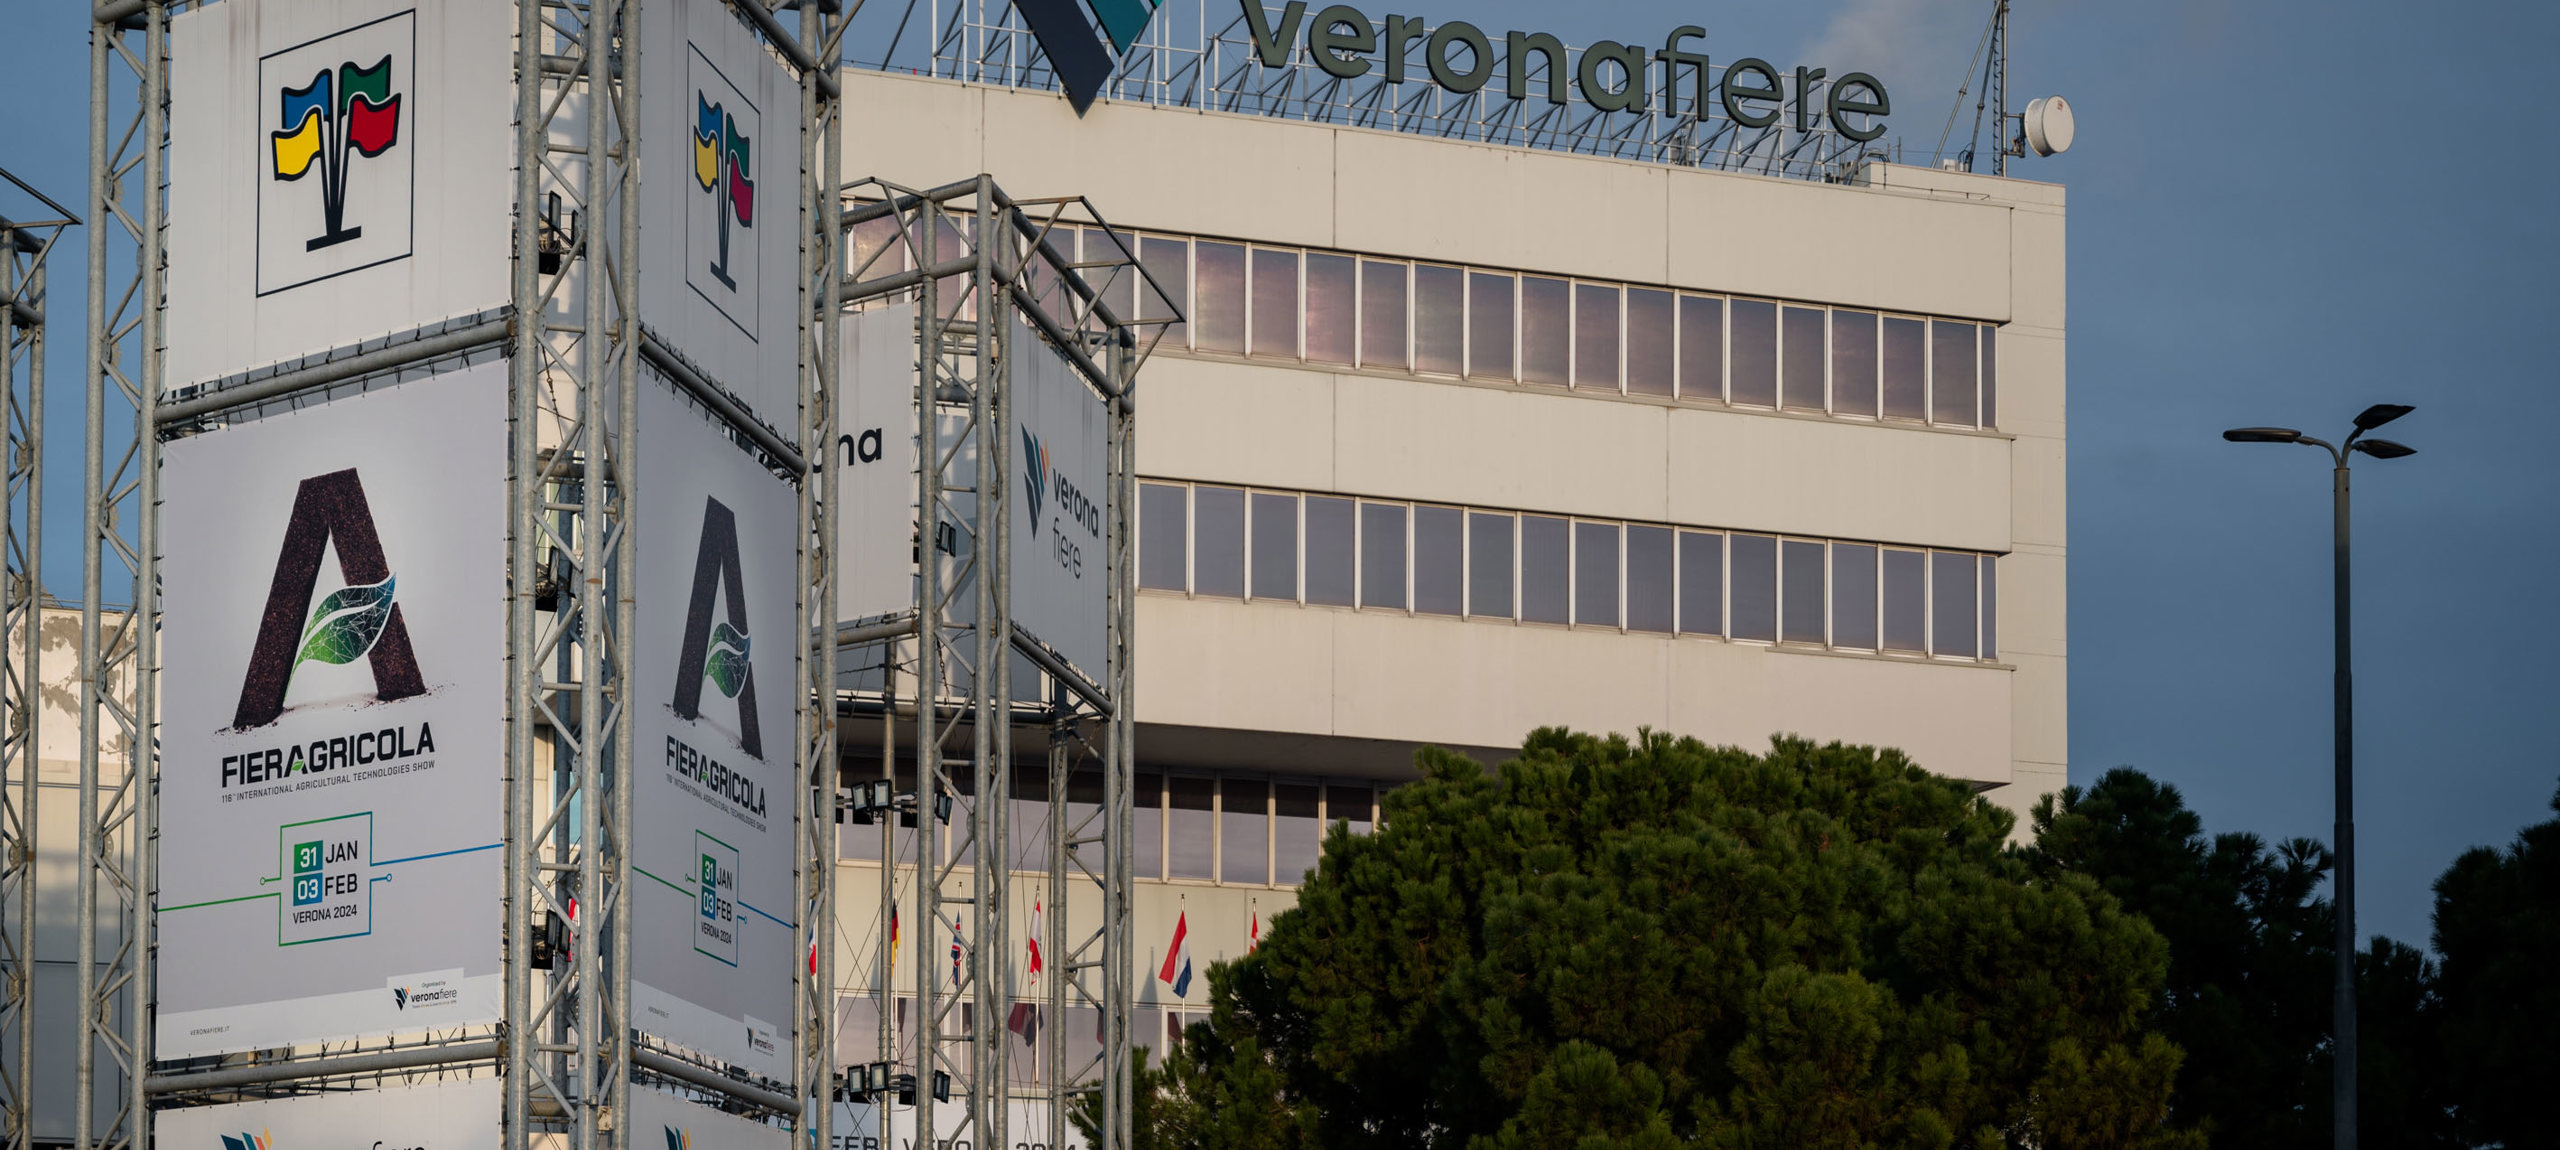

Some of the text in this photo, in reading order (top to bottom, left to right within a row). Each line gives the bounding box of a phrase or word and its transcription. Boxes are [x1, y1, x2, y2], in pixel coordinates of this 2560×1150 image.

[1238, 0, 1890, 142] veronafiere
[1053, 467, 1099, 540] verona
[1053, 516, 1081, 579] fiere
[222, 722, 435, 788] FIERAGRICOLA
[237, 786, 293, 801] INTERNATIONAL
[295, 775, 351, 792] AGRICULTURAL
[353, 764, 410, 781] TECHNOLOGIES
[413, 760, 435, 772] SHOW
[667, 735, 766, 818] FIERAGRICOLA
[300, 840, 358, 868] 31 JAN
[297, 873, 358, 900] 03 FEB
[704, 861, 733, 891] 31 JAN
[293, 904, 357, 924] VERONA 2024
[703, 892, 732, 922] 03 FEB
[700, 920, 732, 945] VERONA 2024
[411, 988, 458, 1003] veronafiere
